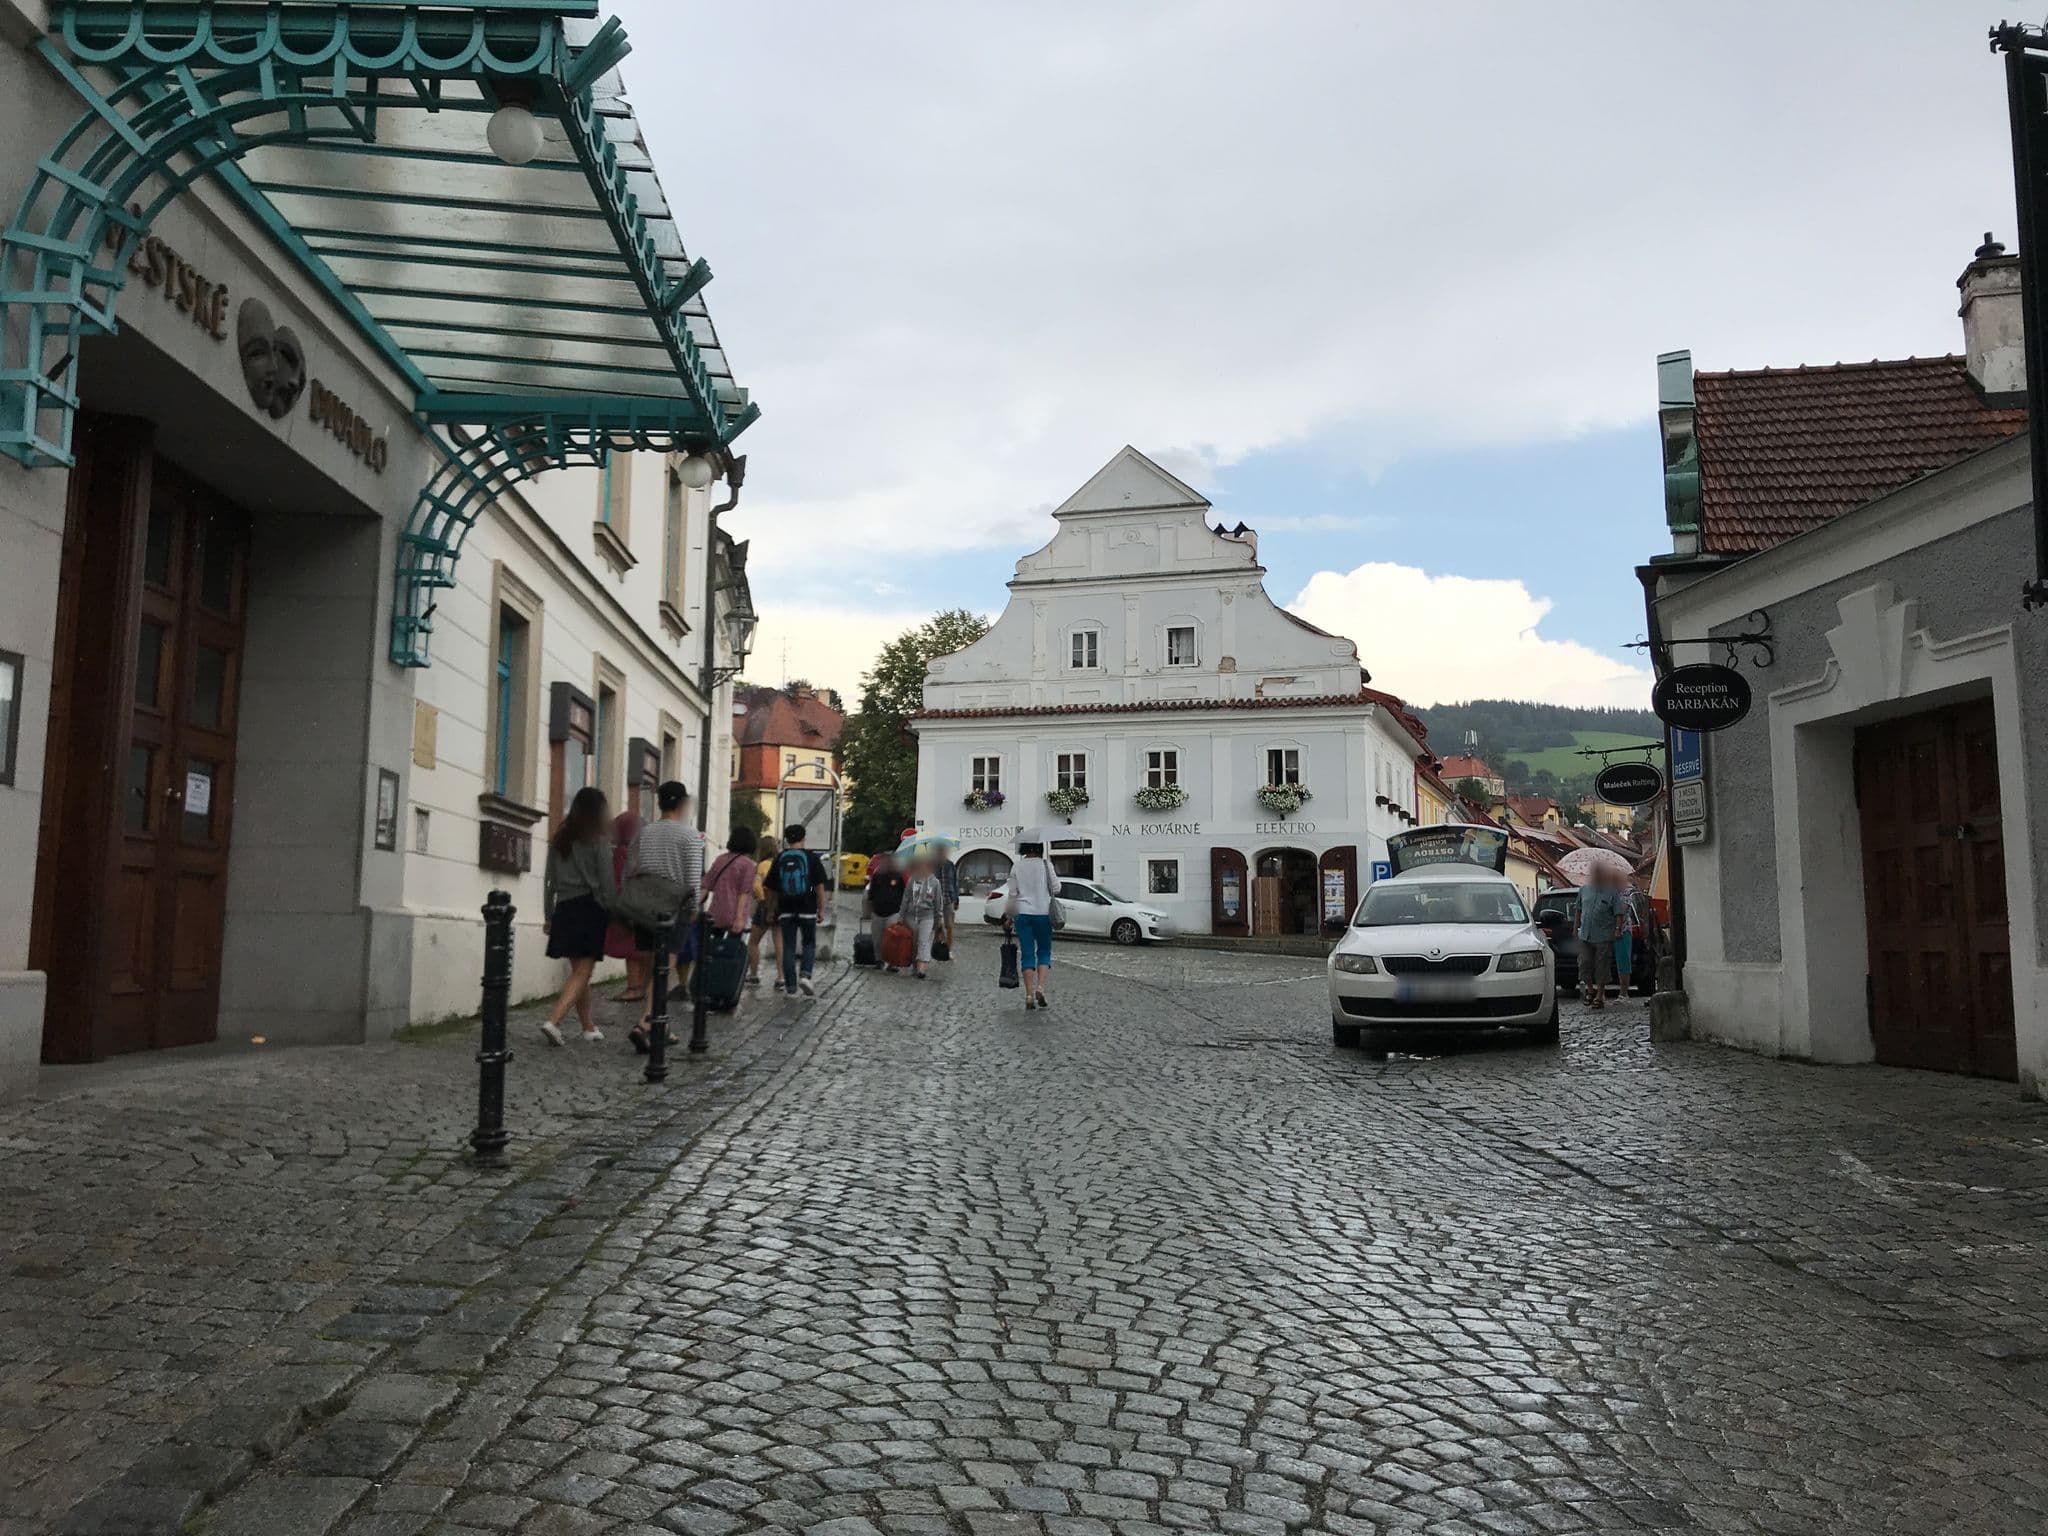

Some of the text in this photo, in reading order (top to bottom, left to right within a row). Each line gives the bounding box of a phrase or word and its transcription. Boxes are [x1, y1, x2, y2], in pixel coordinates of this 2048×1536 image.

[1675, 682, 1728, 696] Reception
[1666, 695, 1739, 710] BARBAKÁN
[1603, 779, 1632, 789] Maleček
[959, 826, 1014, 838] PENSION
[1112, 824, 1131, 835] NA
[1256, 822, 1316, 834] ELEKTRO
[1376, 864, 1388, 880] P
